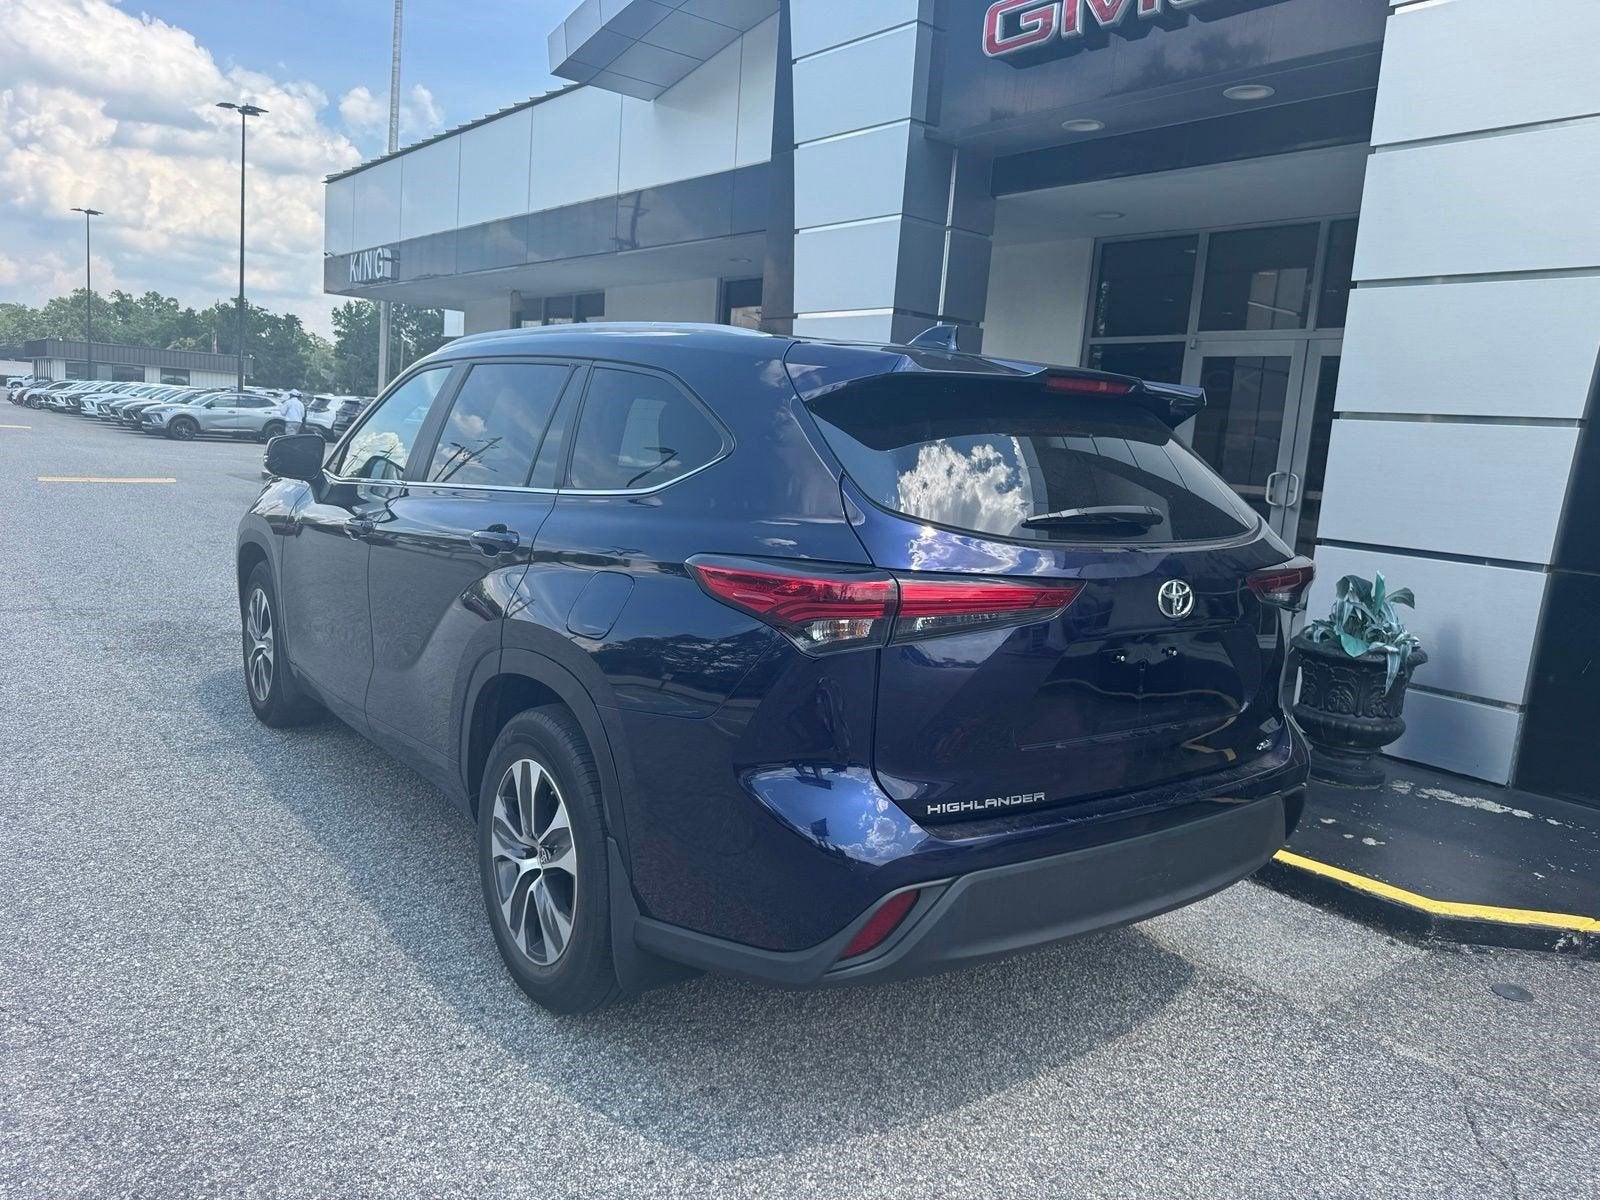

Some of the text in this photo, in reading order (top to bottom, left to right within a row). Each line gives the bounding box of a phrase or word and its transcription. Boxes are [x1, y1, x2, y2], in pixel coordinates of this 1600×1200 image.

[982, 0, 1201, 57] GM
[349, 247, 387, 283] KING
[926, 791, 1046, 815] HIGHLANDER
